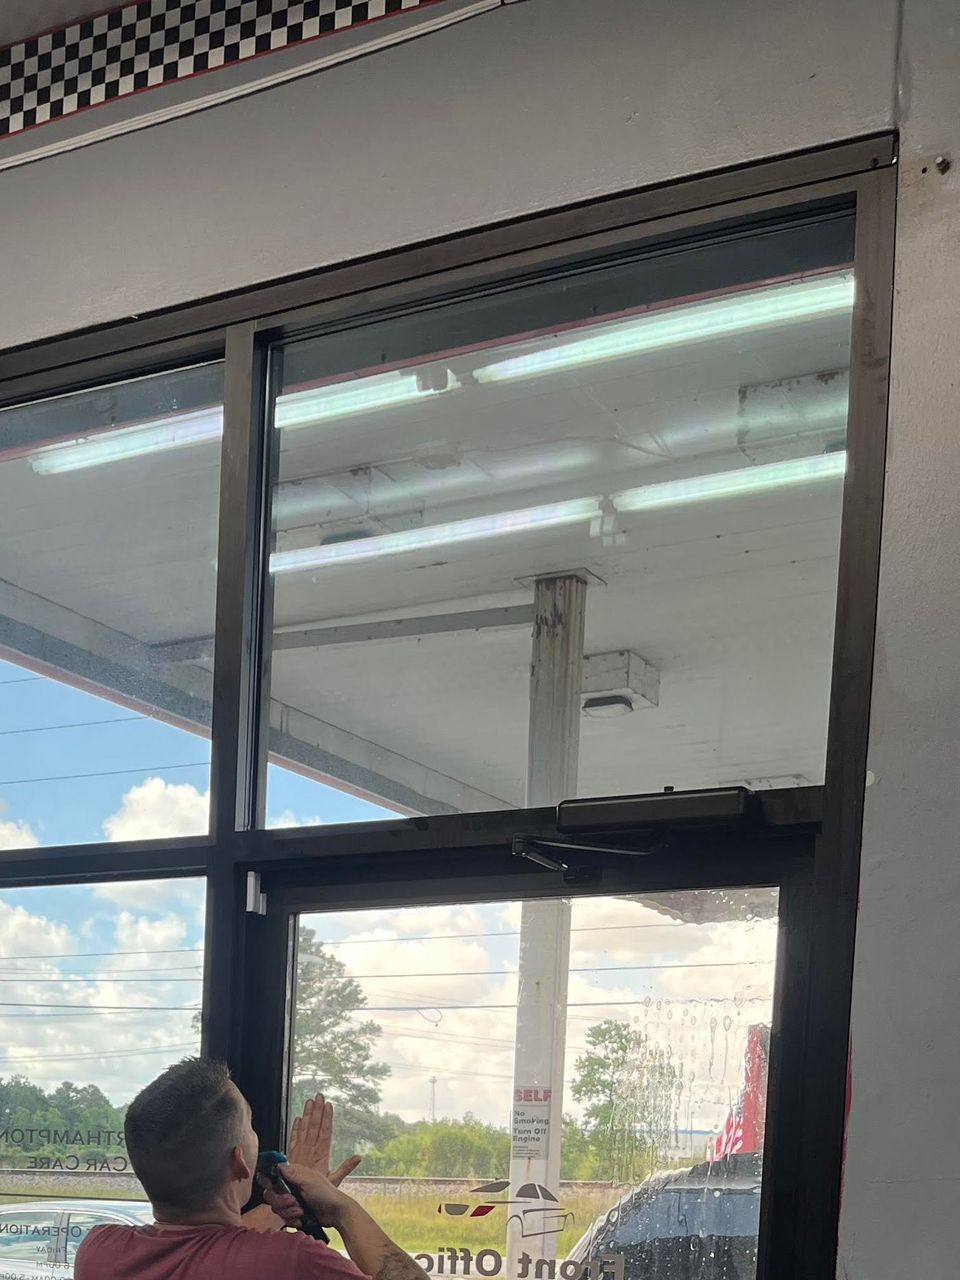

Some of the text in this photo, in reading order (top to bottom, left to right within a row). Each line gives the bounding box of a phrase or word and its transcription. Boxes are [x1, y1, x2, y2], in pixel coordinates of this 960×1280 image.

[514, 1089, 552, 1102] SELF
[514, 1117, 549, 1125] Smoking
[513, 1135, 540, 1143] Engine
